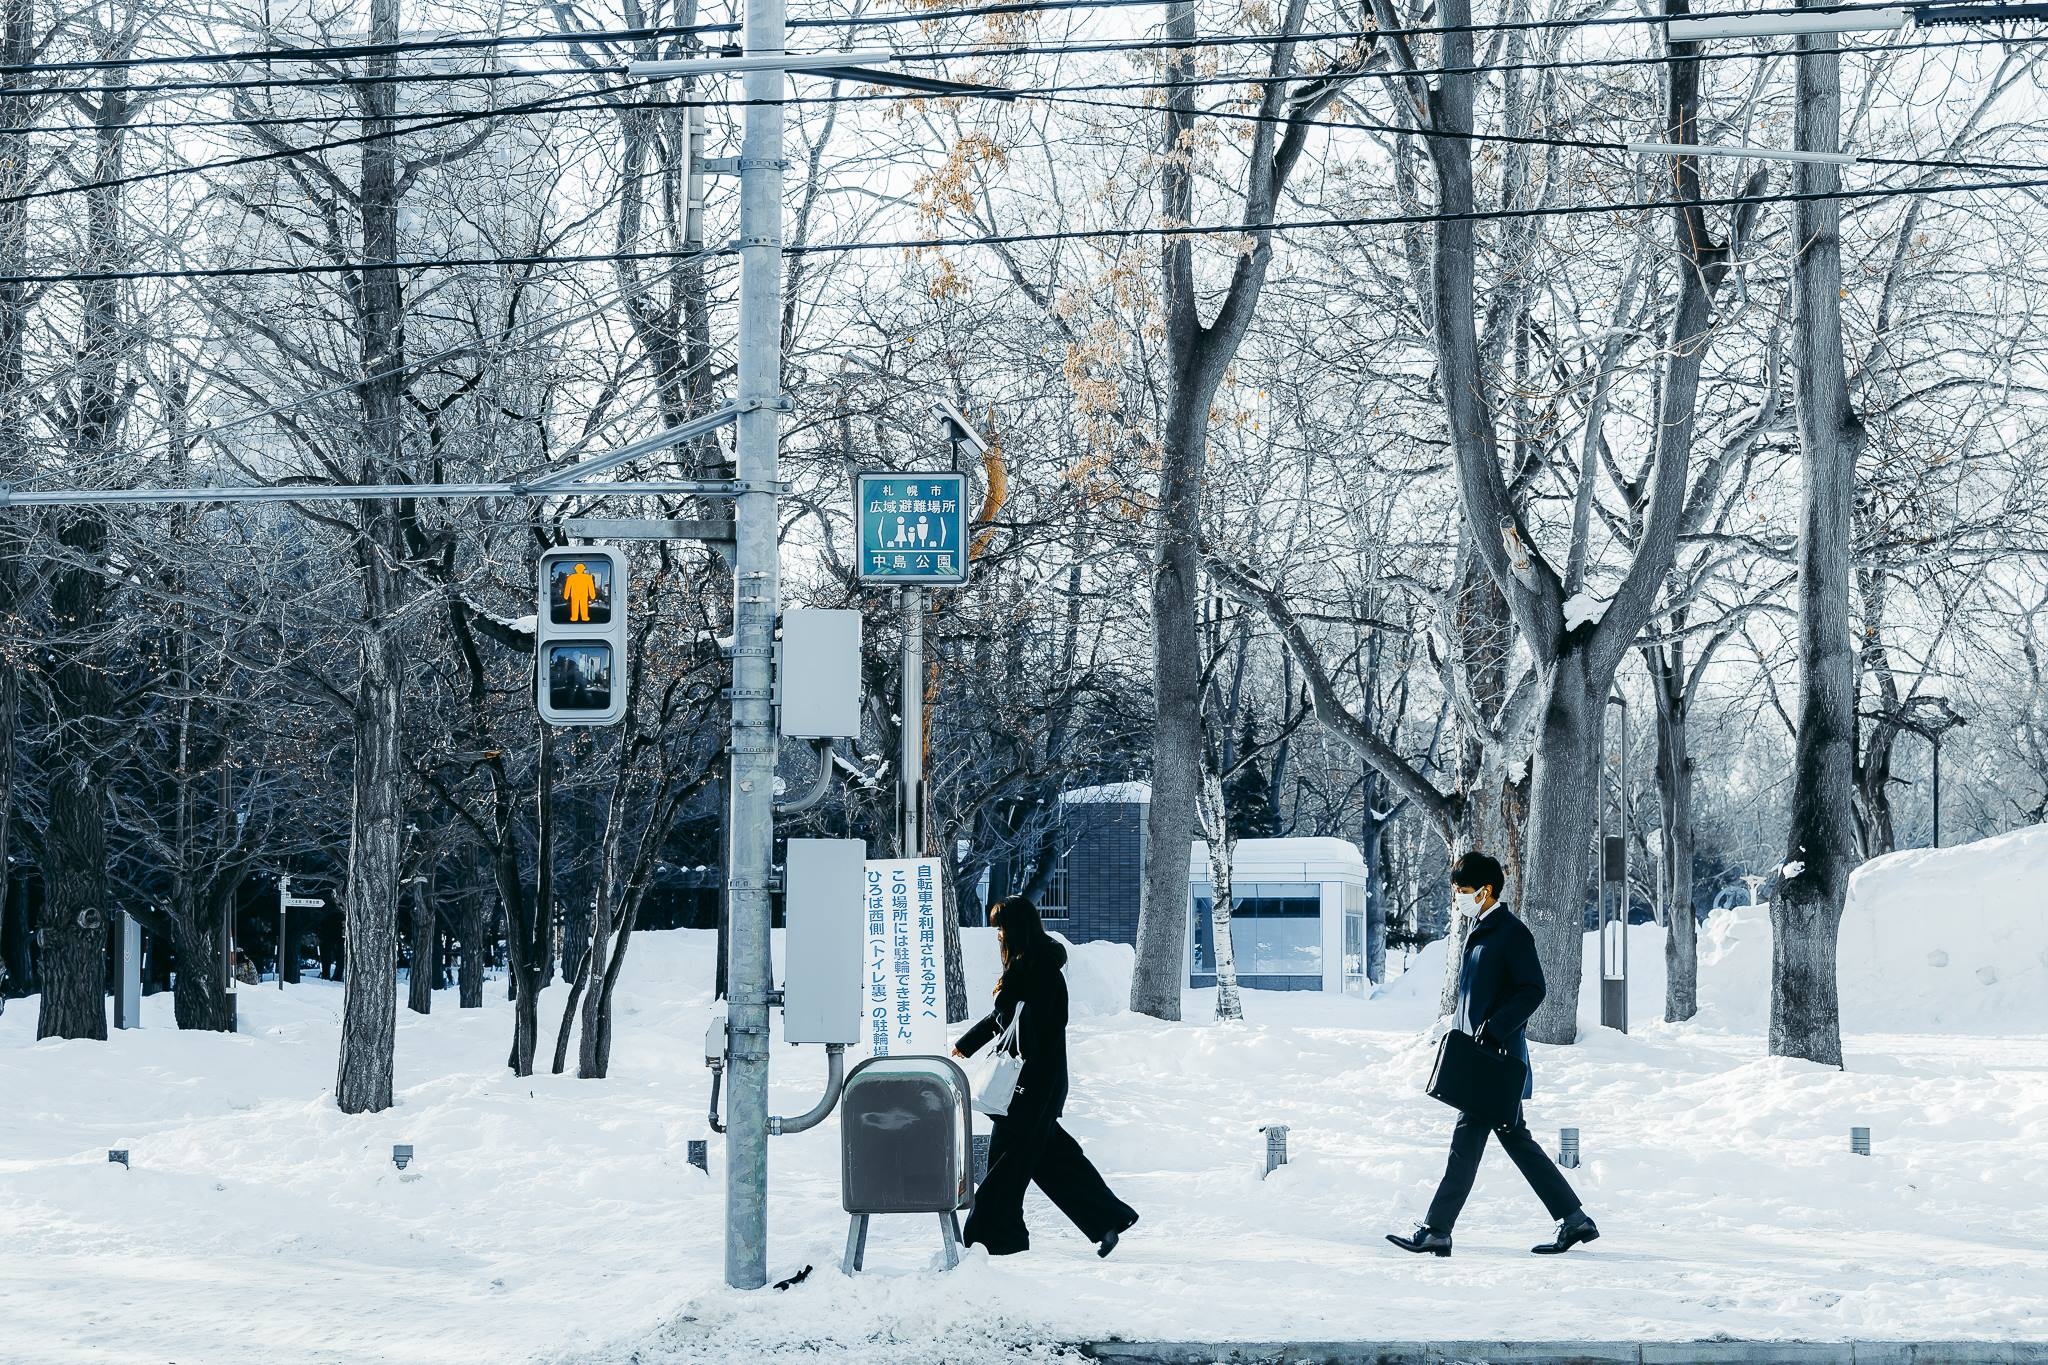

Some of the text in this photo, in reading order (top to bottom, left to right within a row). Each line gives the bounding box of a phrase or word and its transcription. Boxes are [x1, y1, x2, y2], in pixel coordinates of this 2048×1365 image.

[883, 485, 941, 496] 札幌市
[870, 500, 955, 514] 広域避難場所
[873, 554, 951, 569] 中島公園
[917, 864, 938, 1019] 自転車を利用される方々へ
[892, 870, 912, 1045] この場所には駐輪できません。
